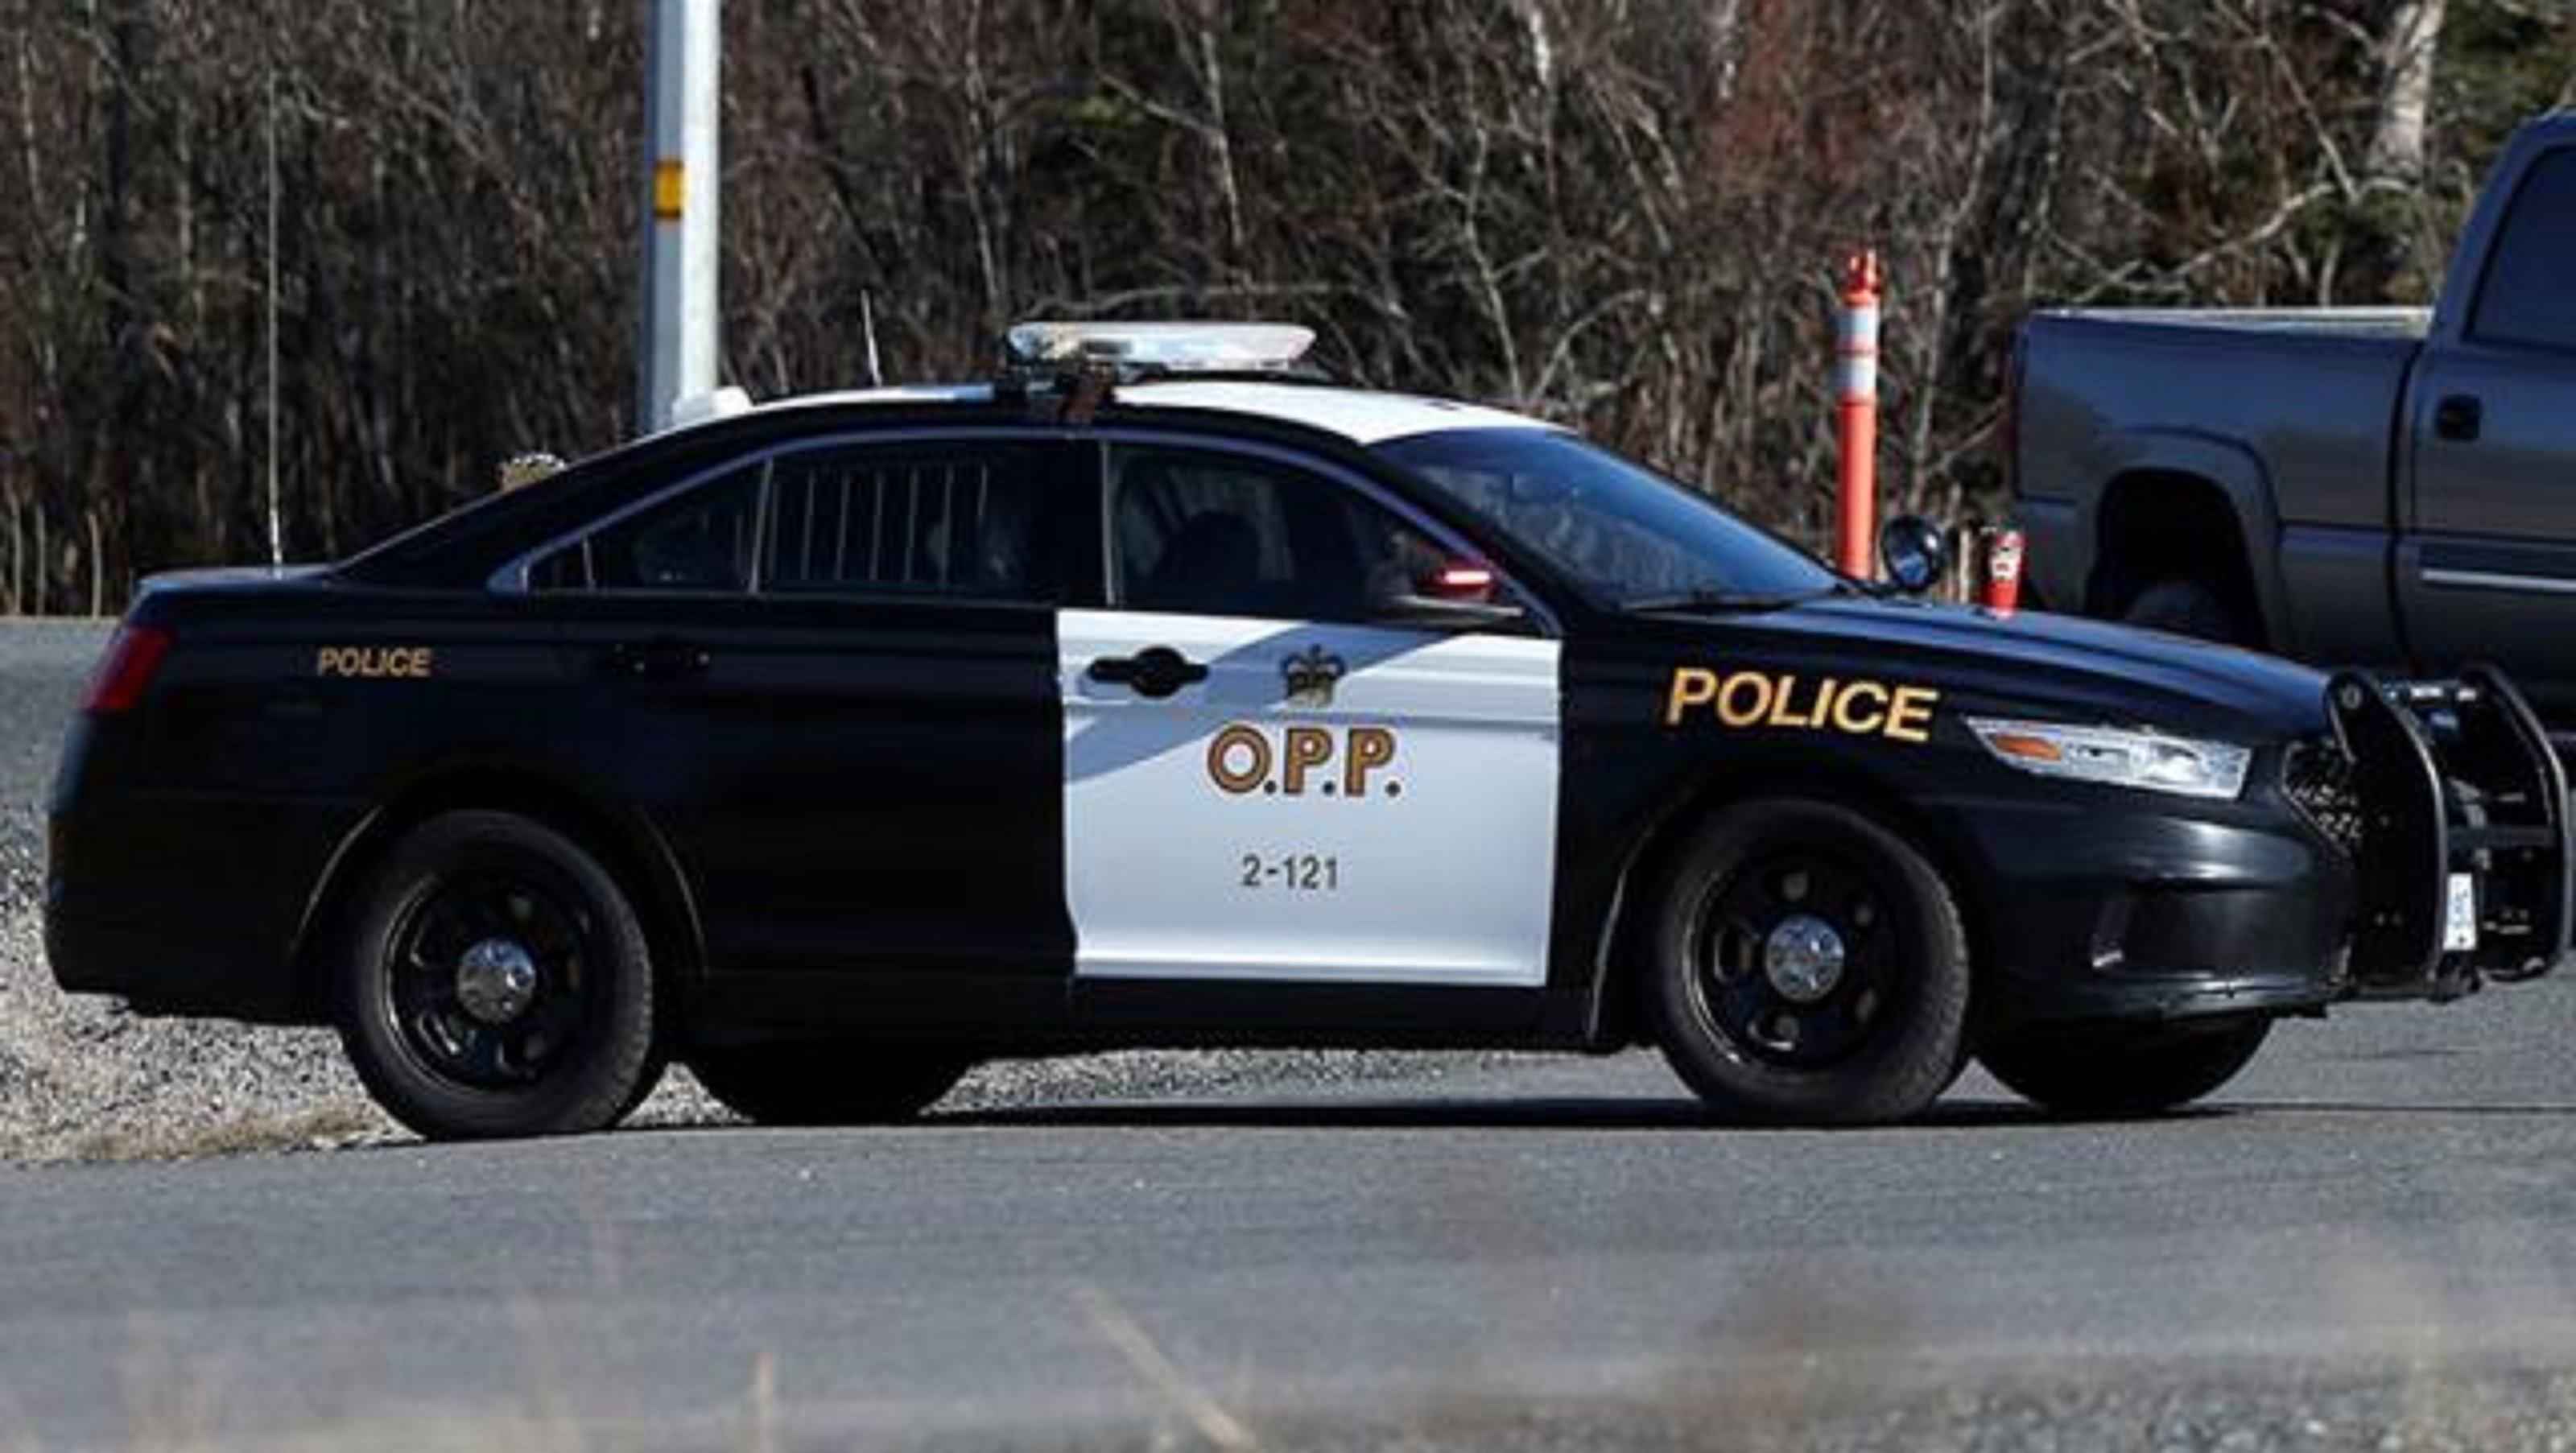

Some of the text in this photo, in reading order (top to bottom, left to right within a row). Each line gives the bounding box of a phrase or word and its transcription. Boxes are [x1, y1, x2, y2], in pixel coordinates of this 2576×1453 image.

[317, 646, 431, 677] POLICE
[1667, 667, 1939, 741] POLICE
[1207, 724, 1402, 797] O.P.P.
[1241, 854, 1339, 890] 2-121
